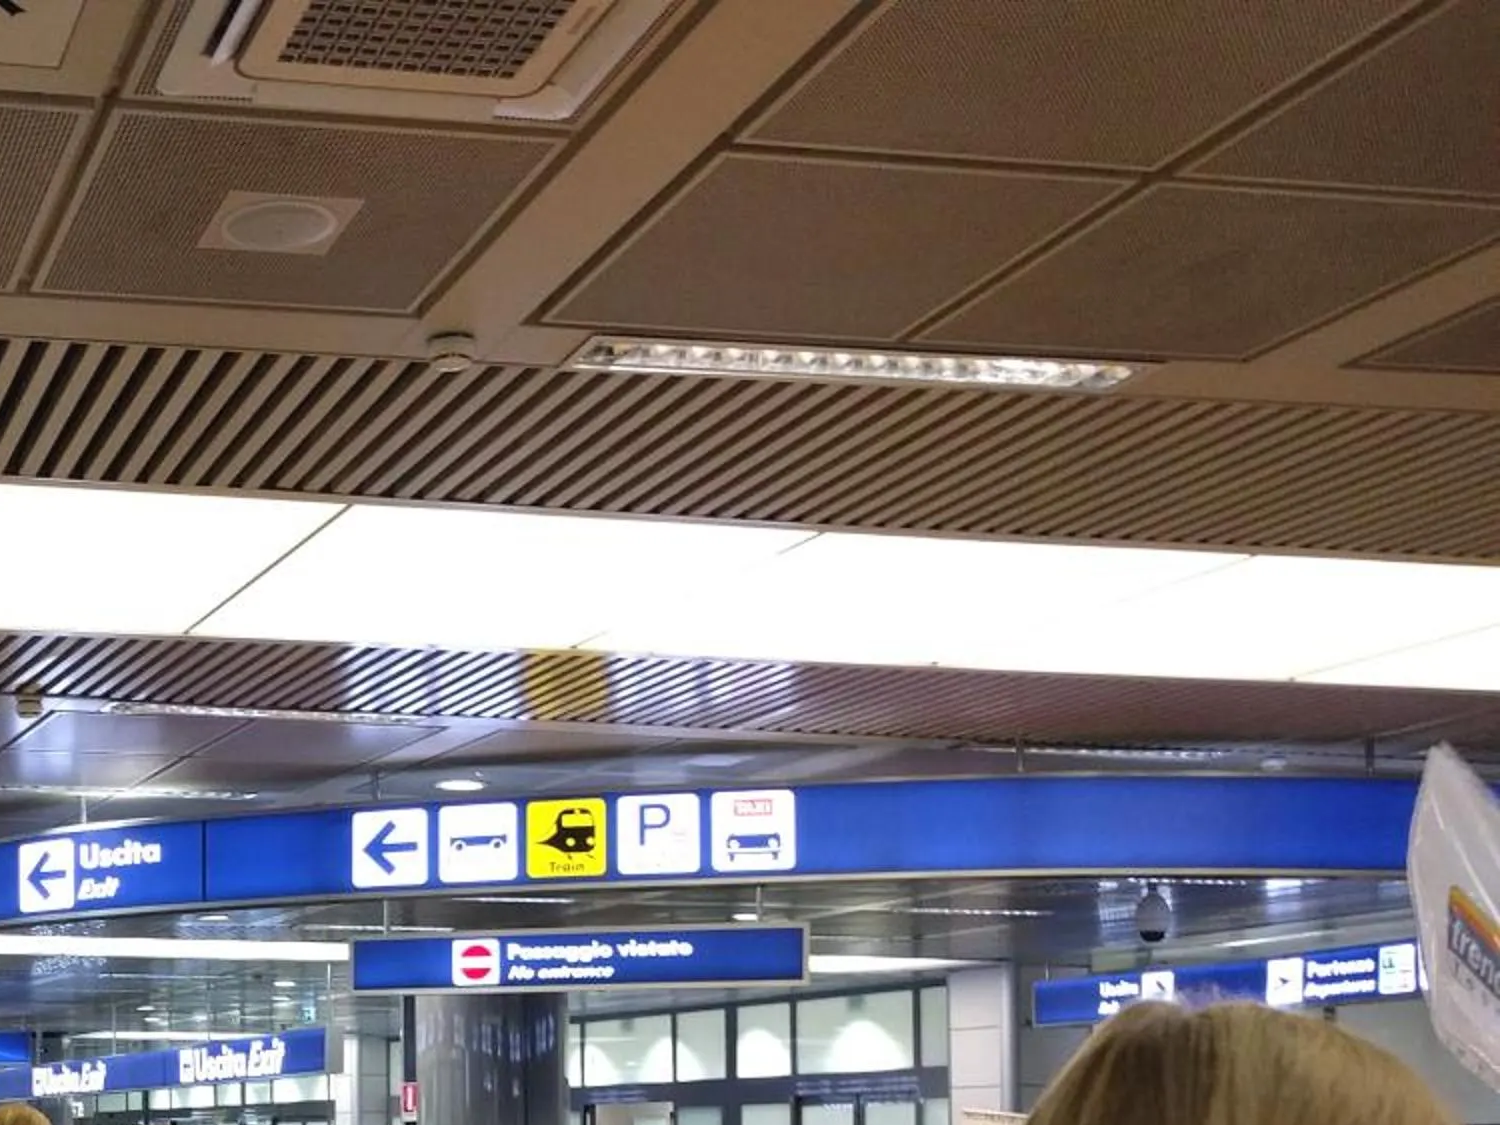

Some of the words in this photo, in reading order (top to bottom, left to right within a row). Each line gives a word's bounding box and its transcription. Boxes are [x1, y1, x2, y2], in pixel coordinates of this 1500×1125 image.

[639, 803, 671, 846] P
[79, 839, 162, 870] Uscita
[77, 876, 120, 900] Exit
[506, 940, 613, 963] Passaggio
[616, 939, 693, 957] vietato
[507, 965, 535, 980] No
[536, 966, 615, 980] entrance
[194, 1043, 247, 1081] Uscita
[247, 1037, 285, 1077] Exit
